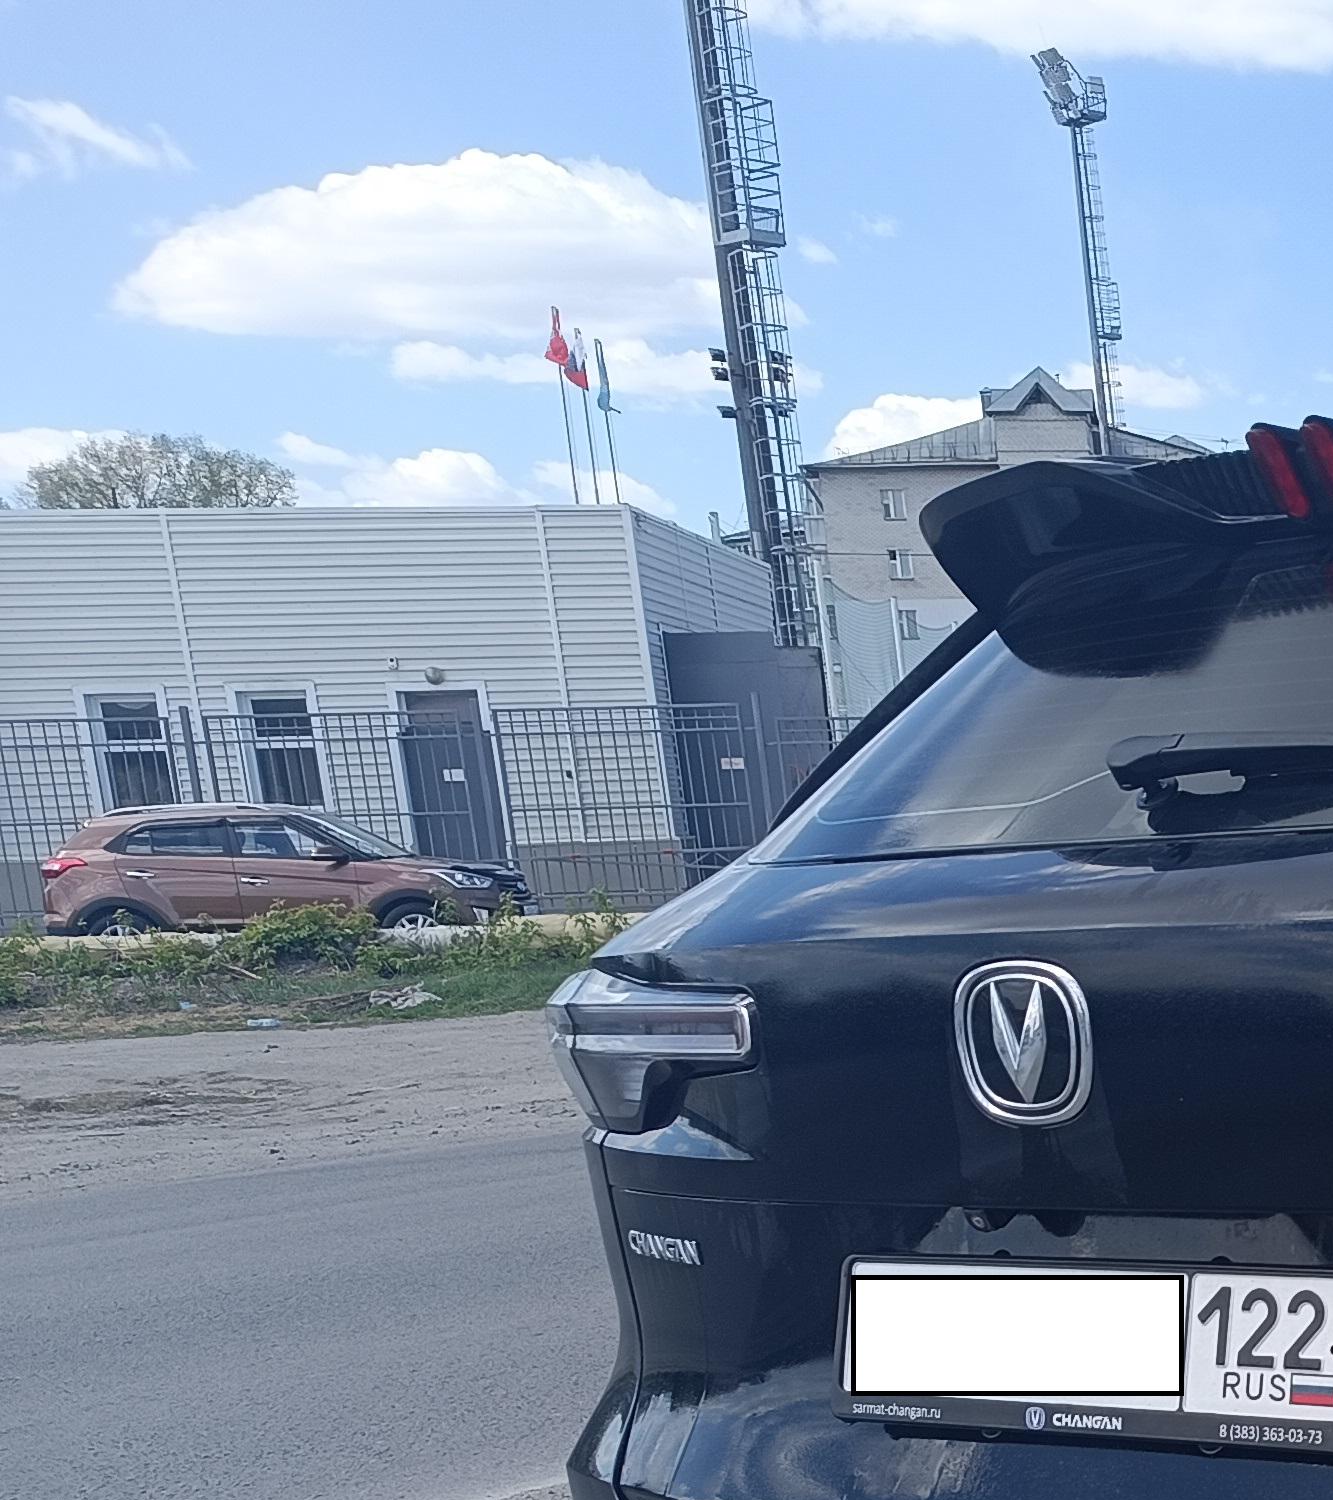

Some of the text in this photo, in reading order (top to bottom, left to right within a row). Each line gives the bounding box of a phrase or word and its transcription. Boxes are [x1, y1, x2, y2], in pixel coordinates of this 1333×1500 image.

[628, 1229, 701, 1265] CHANGAN
[1198, 1286, 1325, 1369] 122
[1222, 1372, 1287, 1402] RUS
[852, 1402, 941, 1420] sarmat-changan.ru
[1052, 1413, 1123, 1431] CHANGAN
[1219, 1423, 1323, 1445] 8 (383) 363-03-73
